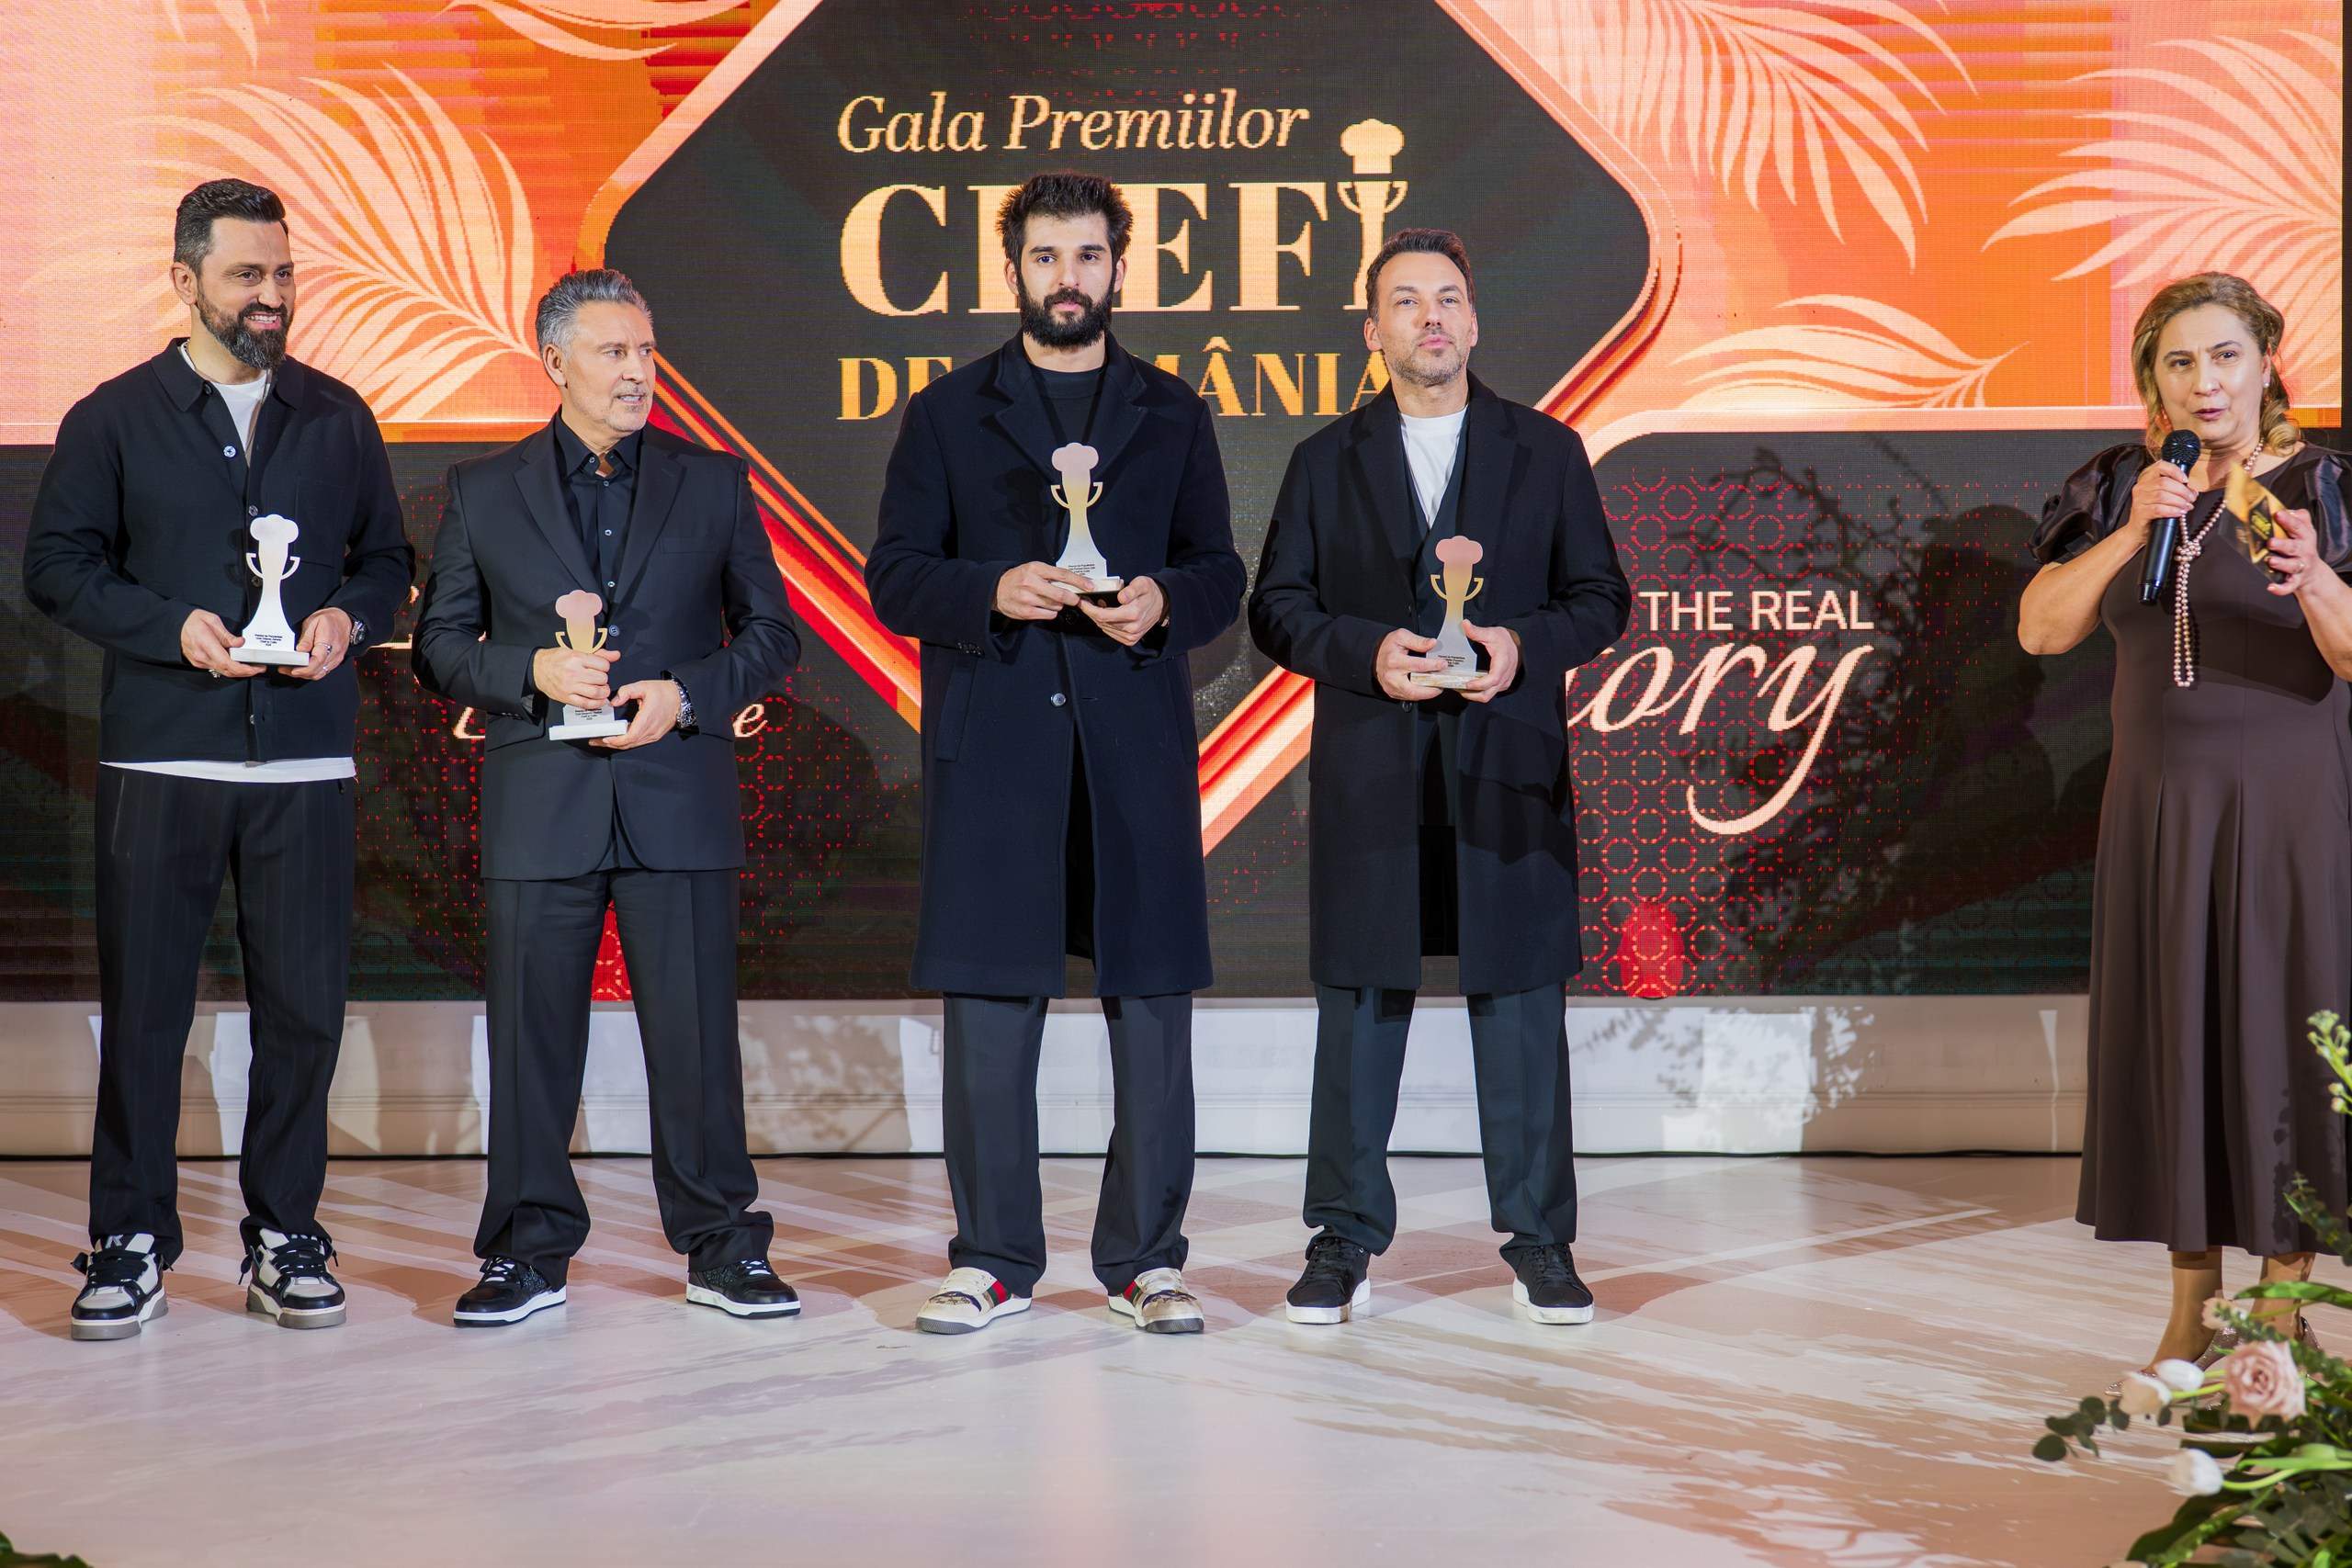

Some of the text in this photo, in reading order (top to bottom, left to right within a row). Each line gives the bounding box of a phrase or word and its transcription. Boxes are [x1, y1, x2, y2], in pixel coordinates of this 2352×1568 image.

[837, 88, 1310, 153] Gala Premiilor
[1638, 590, 1874, 631] THE REAL
[1566, 642, 1874, 835] ory
